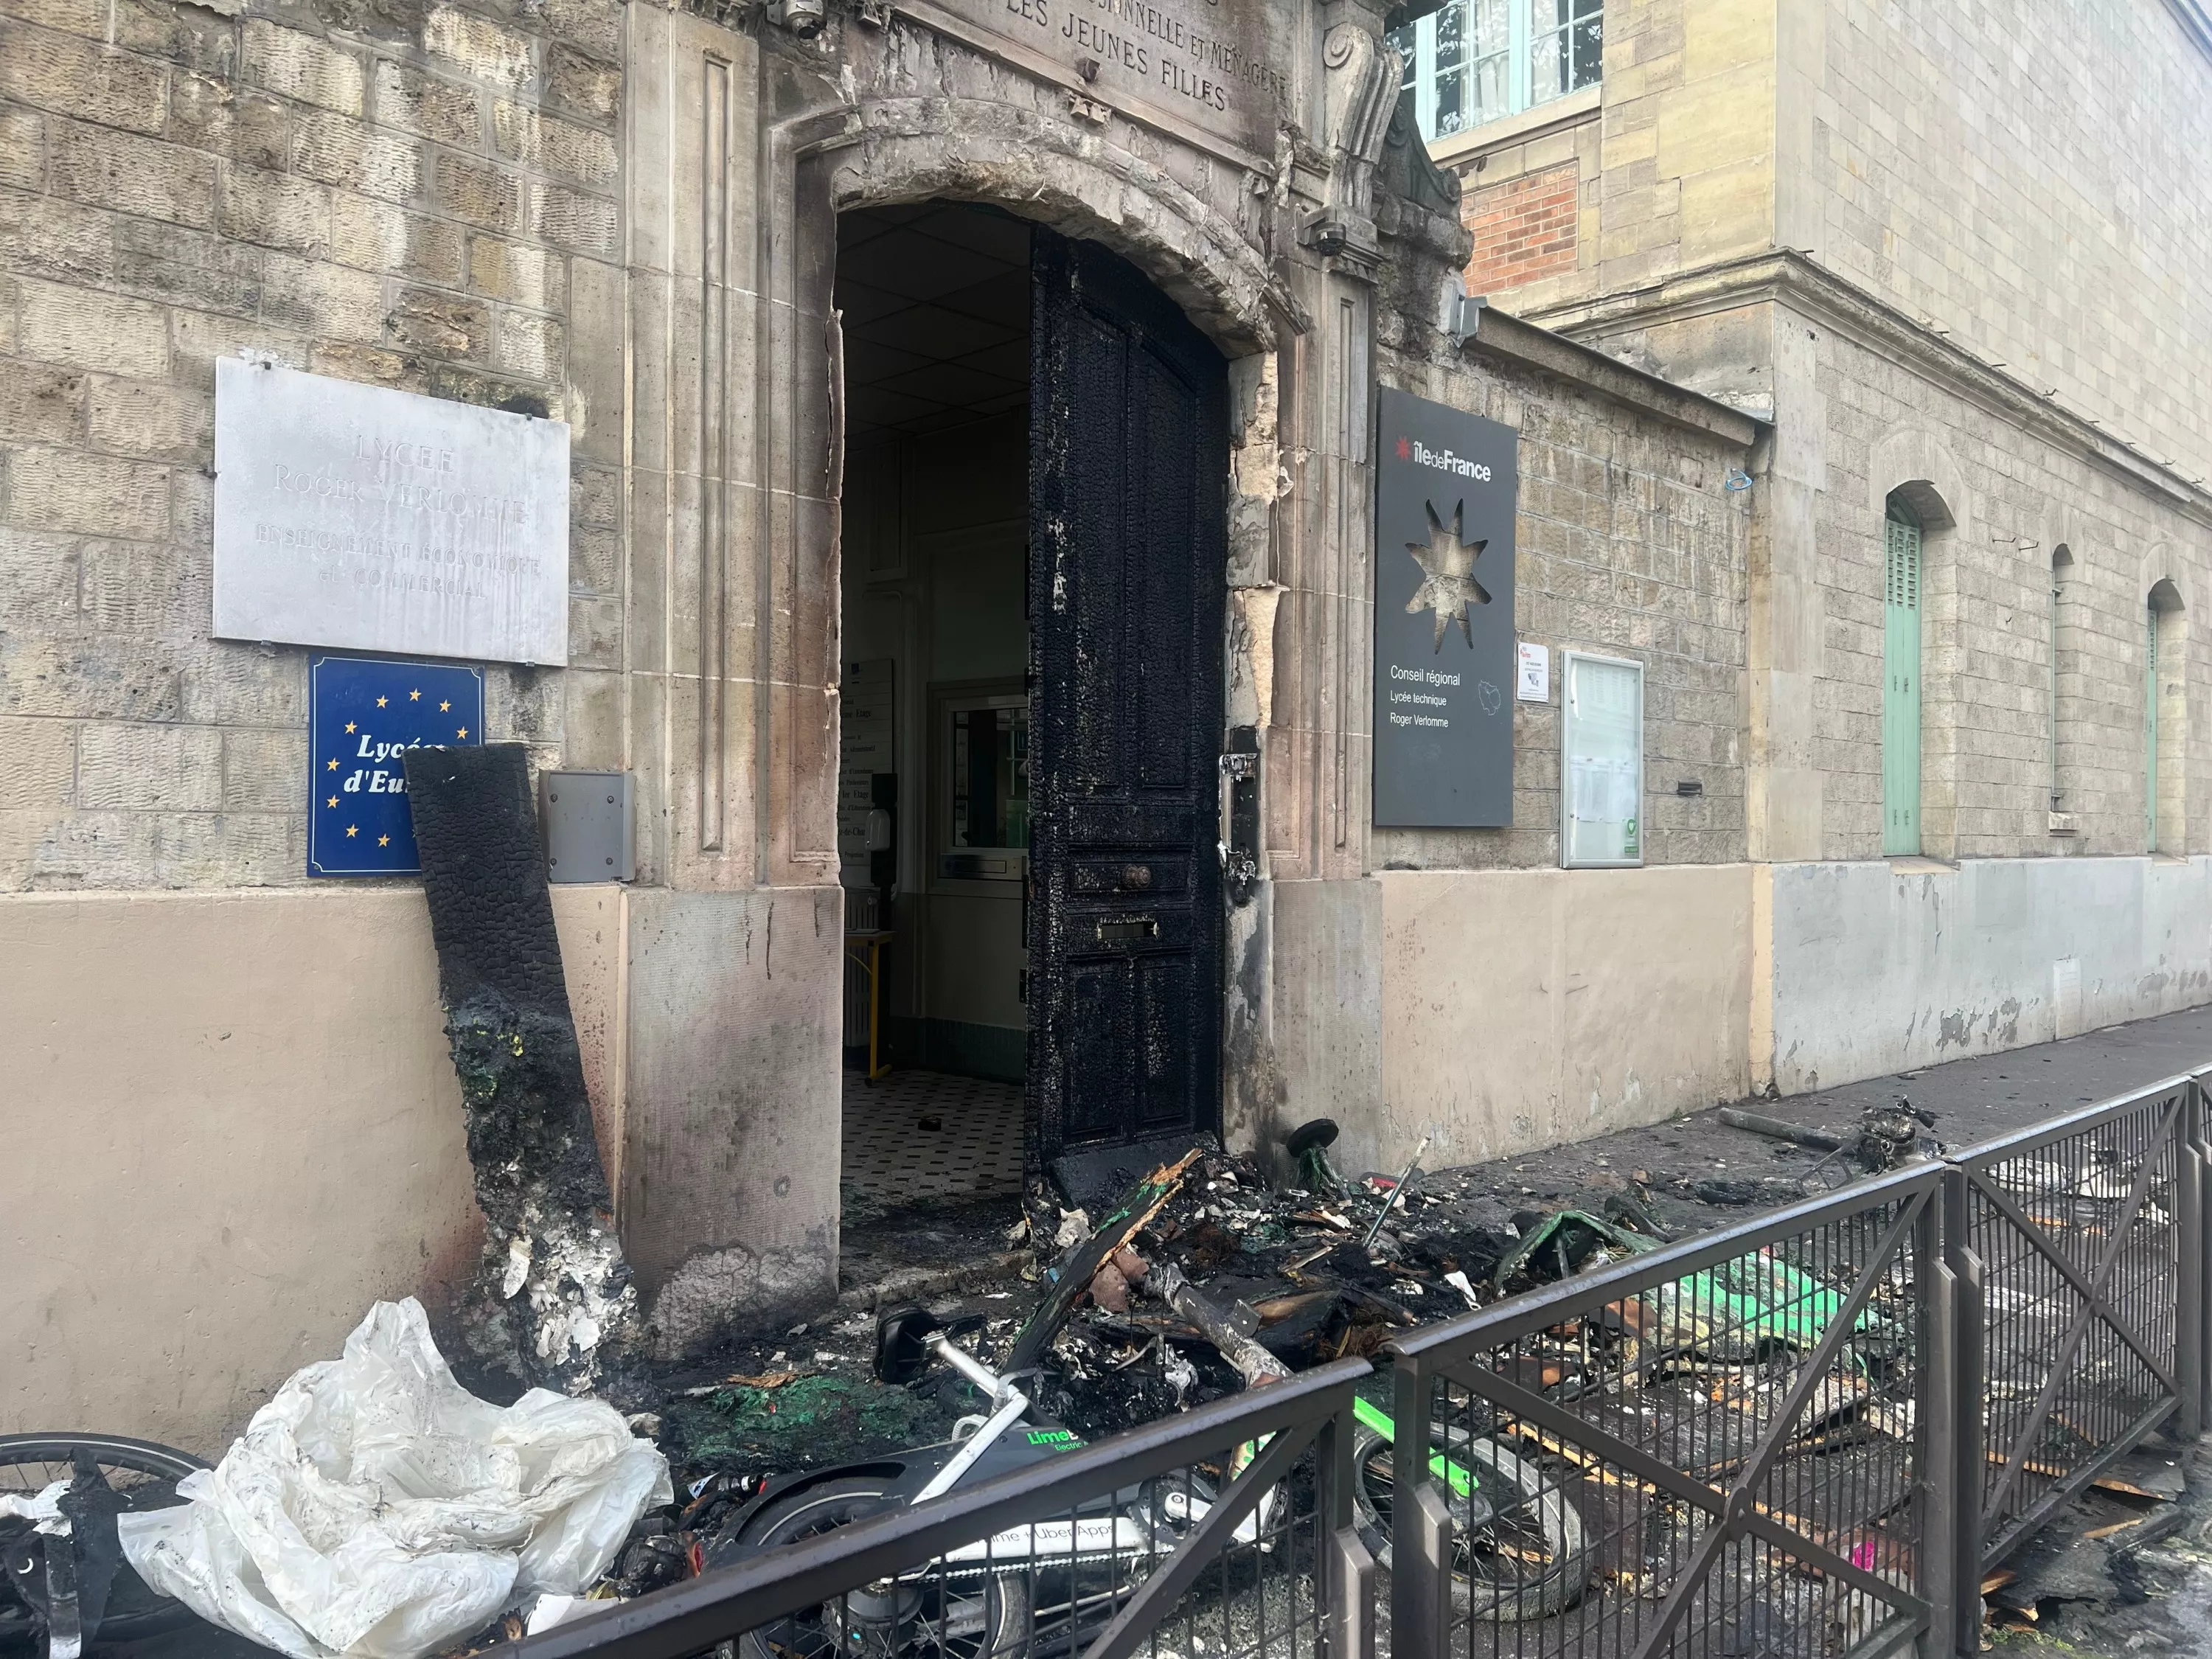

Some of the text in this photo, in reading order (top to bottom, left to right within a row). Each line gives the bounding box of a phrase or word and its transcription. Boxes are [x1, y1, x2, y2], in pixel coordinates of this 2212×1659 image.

[1190, 34, 1206, 60] ET
[1062, 13, 1148, 74] JEUNES
[1161, 59, 1227, 111] FILLES
[256, 524, 411, 559] ENSEIGNEMENT
[319, 564, 487, 599] et COMMERCIAL
[1391, 664, 1461, 687] Conseil régional
[1390, 689, 1447, 708] Lycée technique
[1390, 712, 1449, 728] Roger Verlomme
[344, 769, 408, 793] d'Eu
[1054, 1441, 1083, 1451] Electric
[990, 1533, 1020, 1543] ime
[1034, 1526, 1072, 1540] Uber
